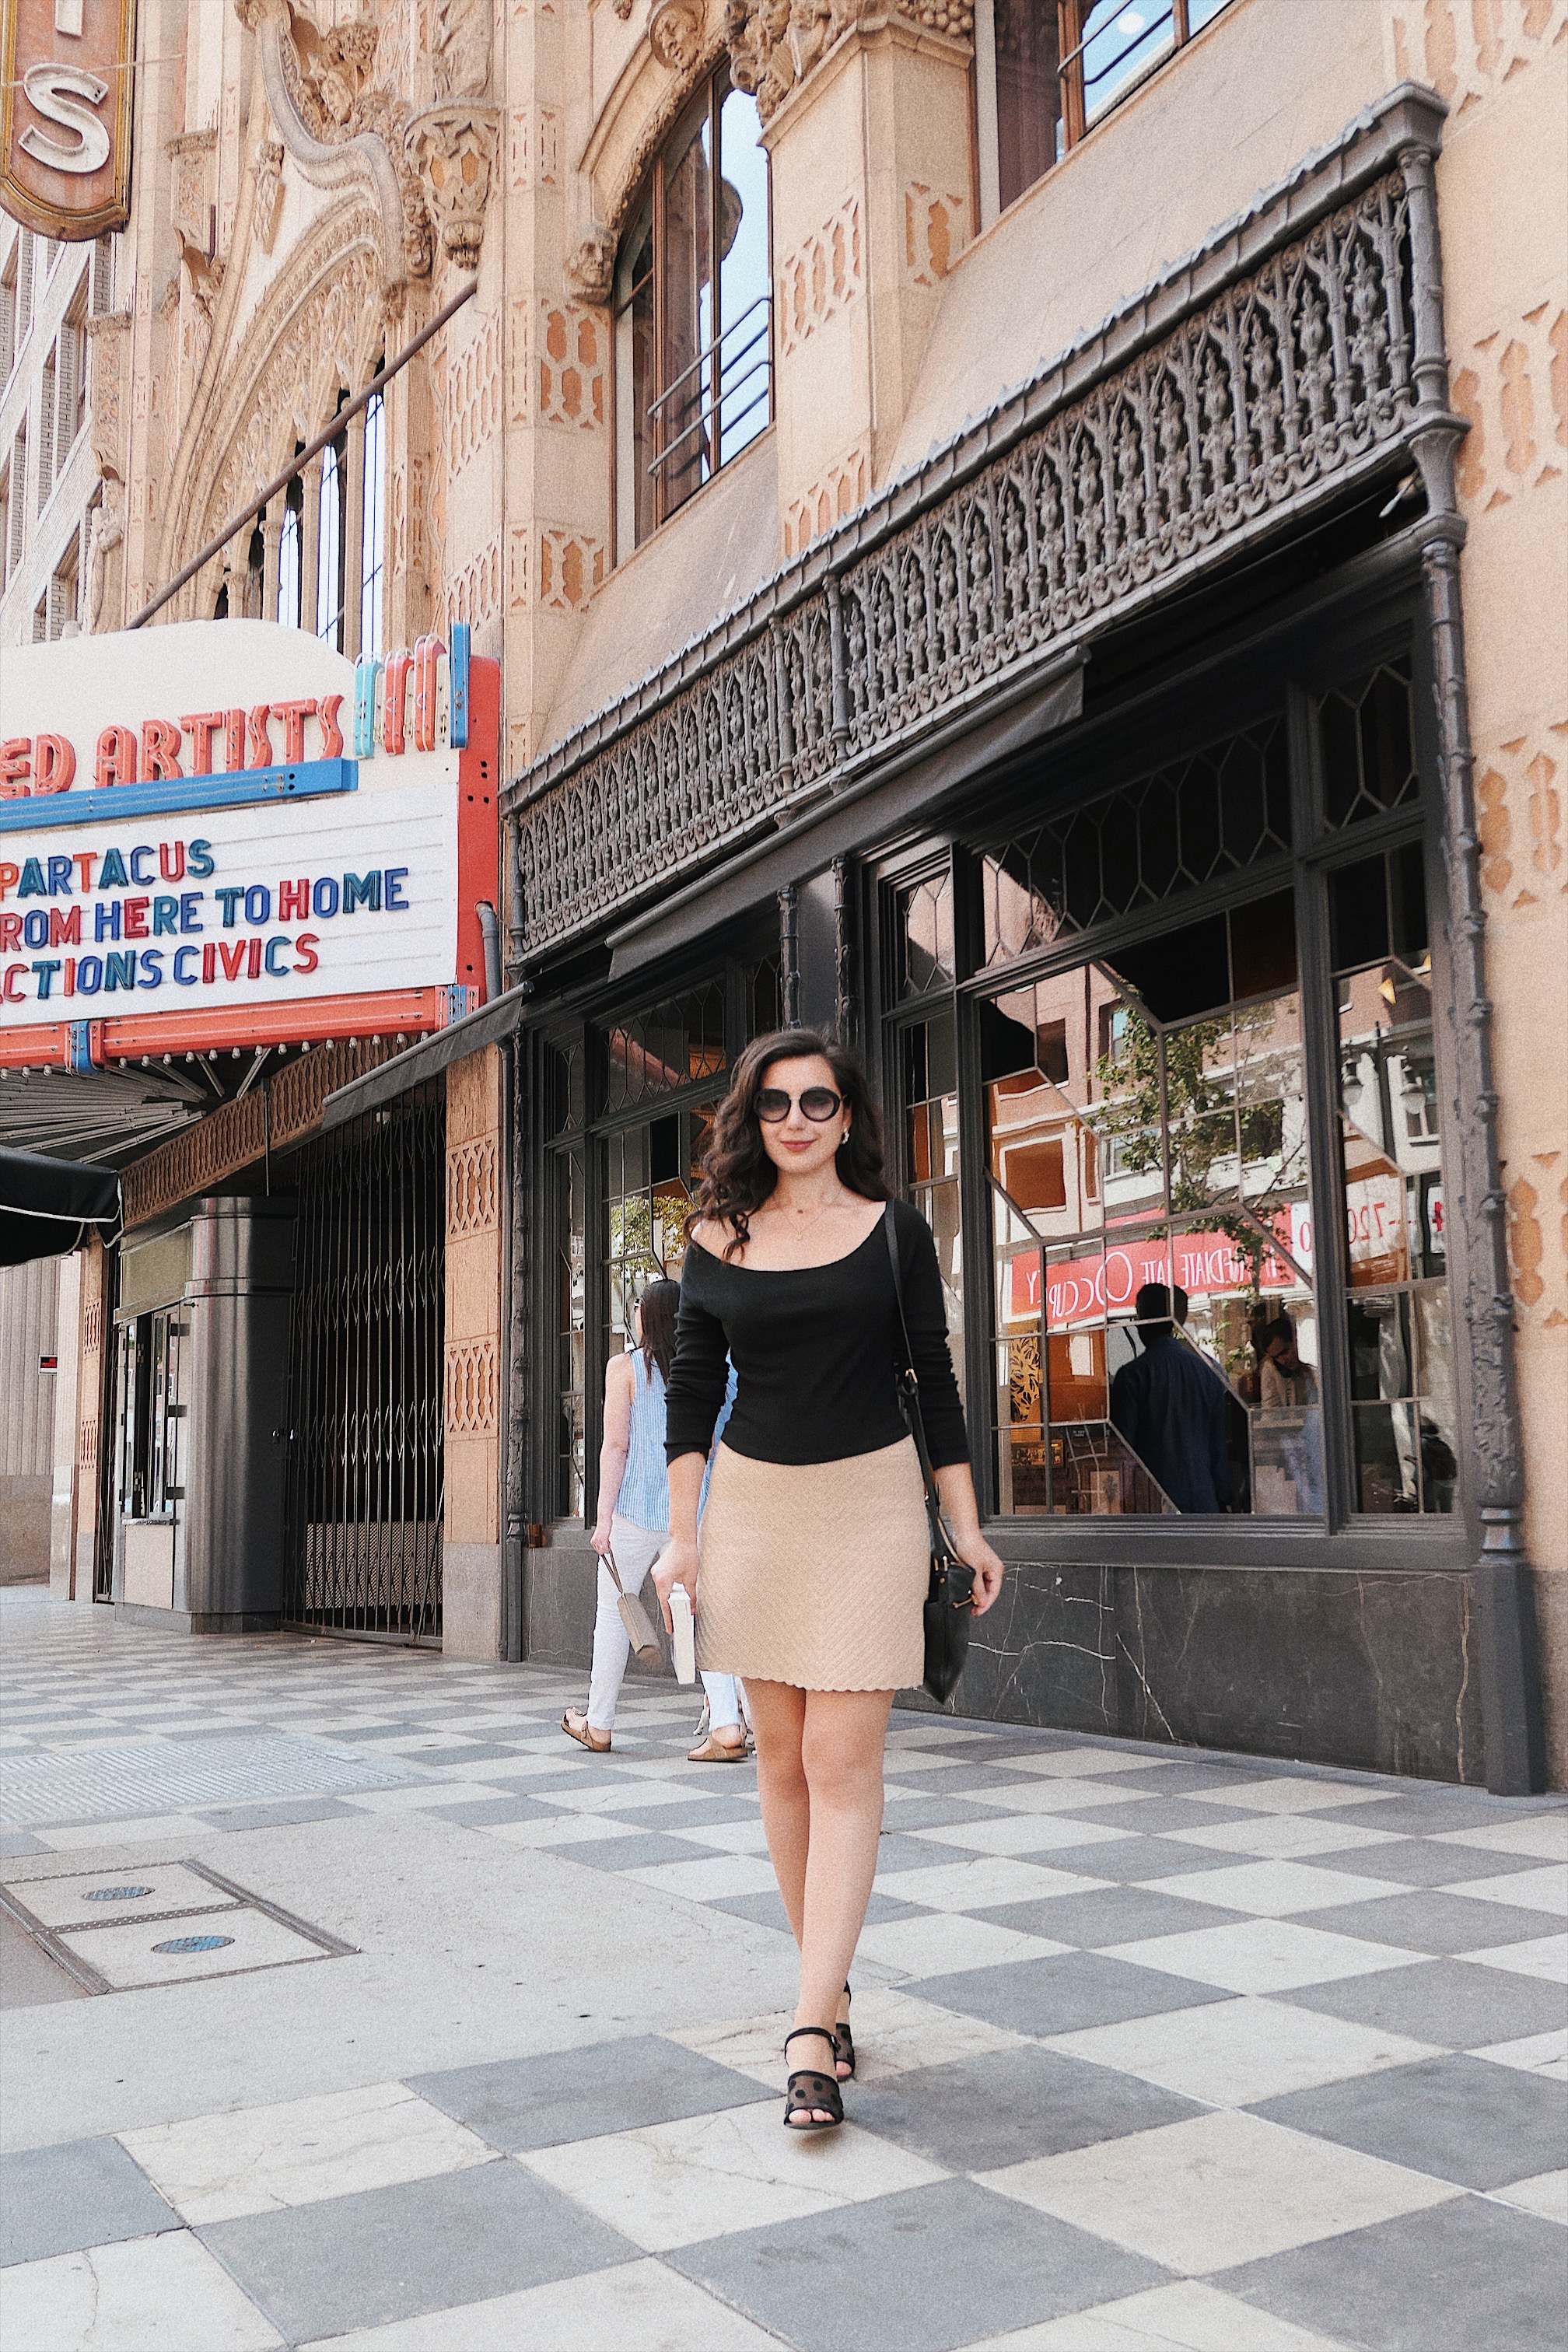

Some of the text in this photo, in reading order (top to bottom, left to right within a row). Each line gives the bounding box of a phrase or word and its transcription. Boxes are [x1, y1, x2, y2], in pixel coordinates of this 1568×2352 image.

[0, 695, 345, 799] ED ARTISTS
[0, 839, 215, 901] PARTACUS
[0, 867, 409, 952] ROM HERE TO HOME
[0, 933, 320, 1003] CTIONS CIVICS
